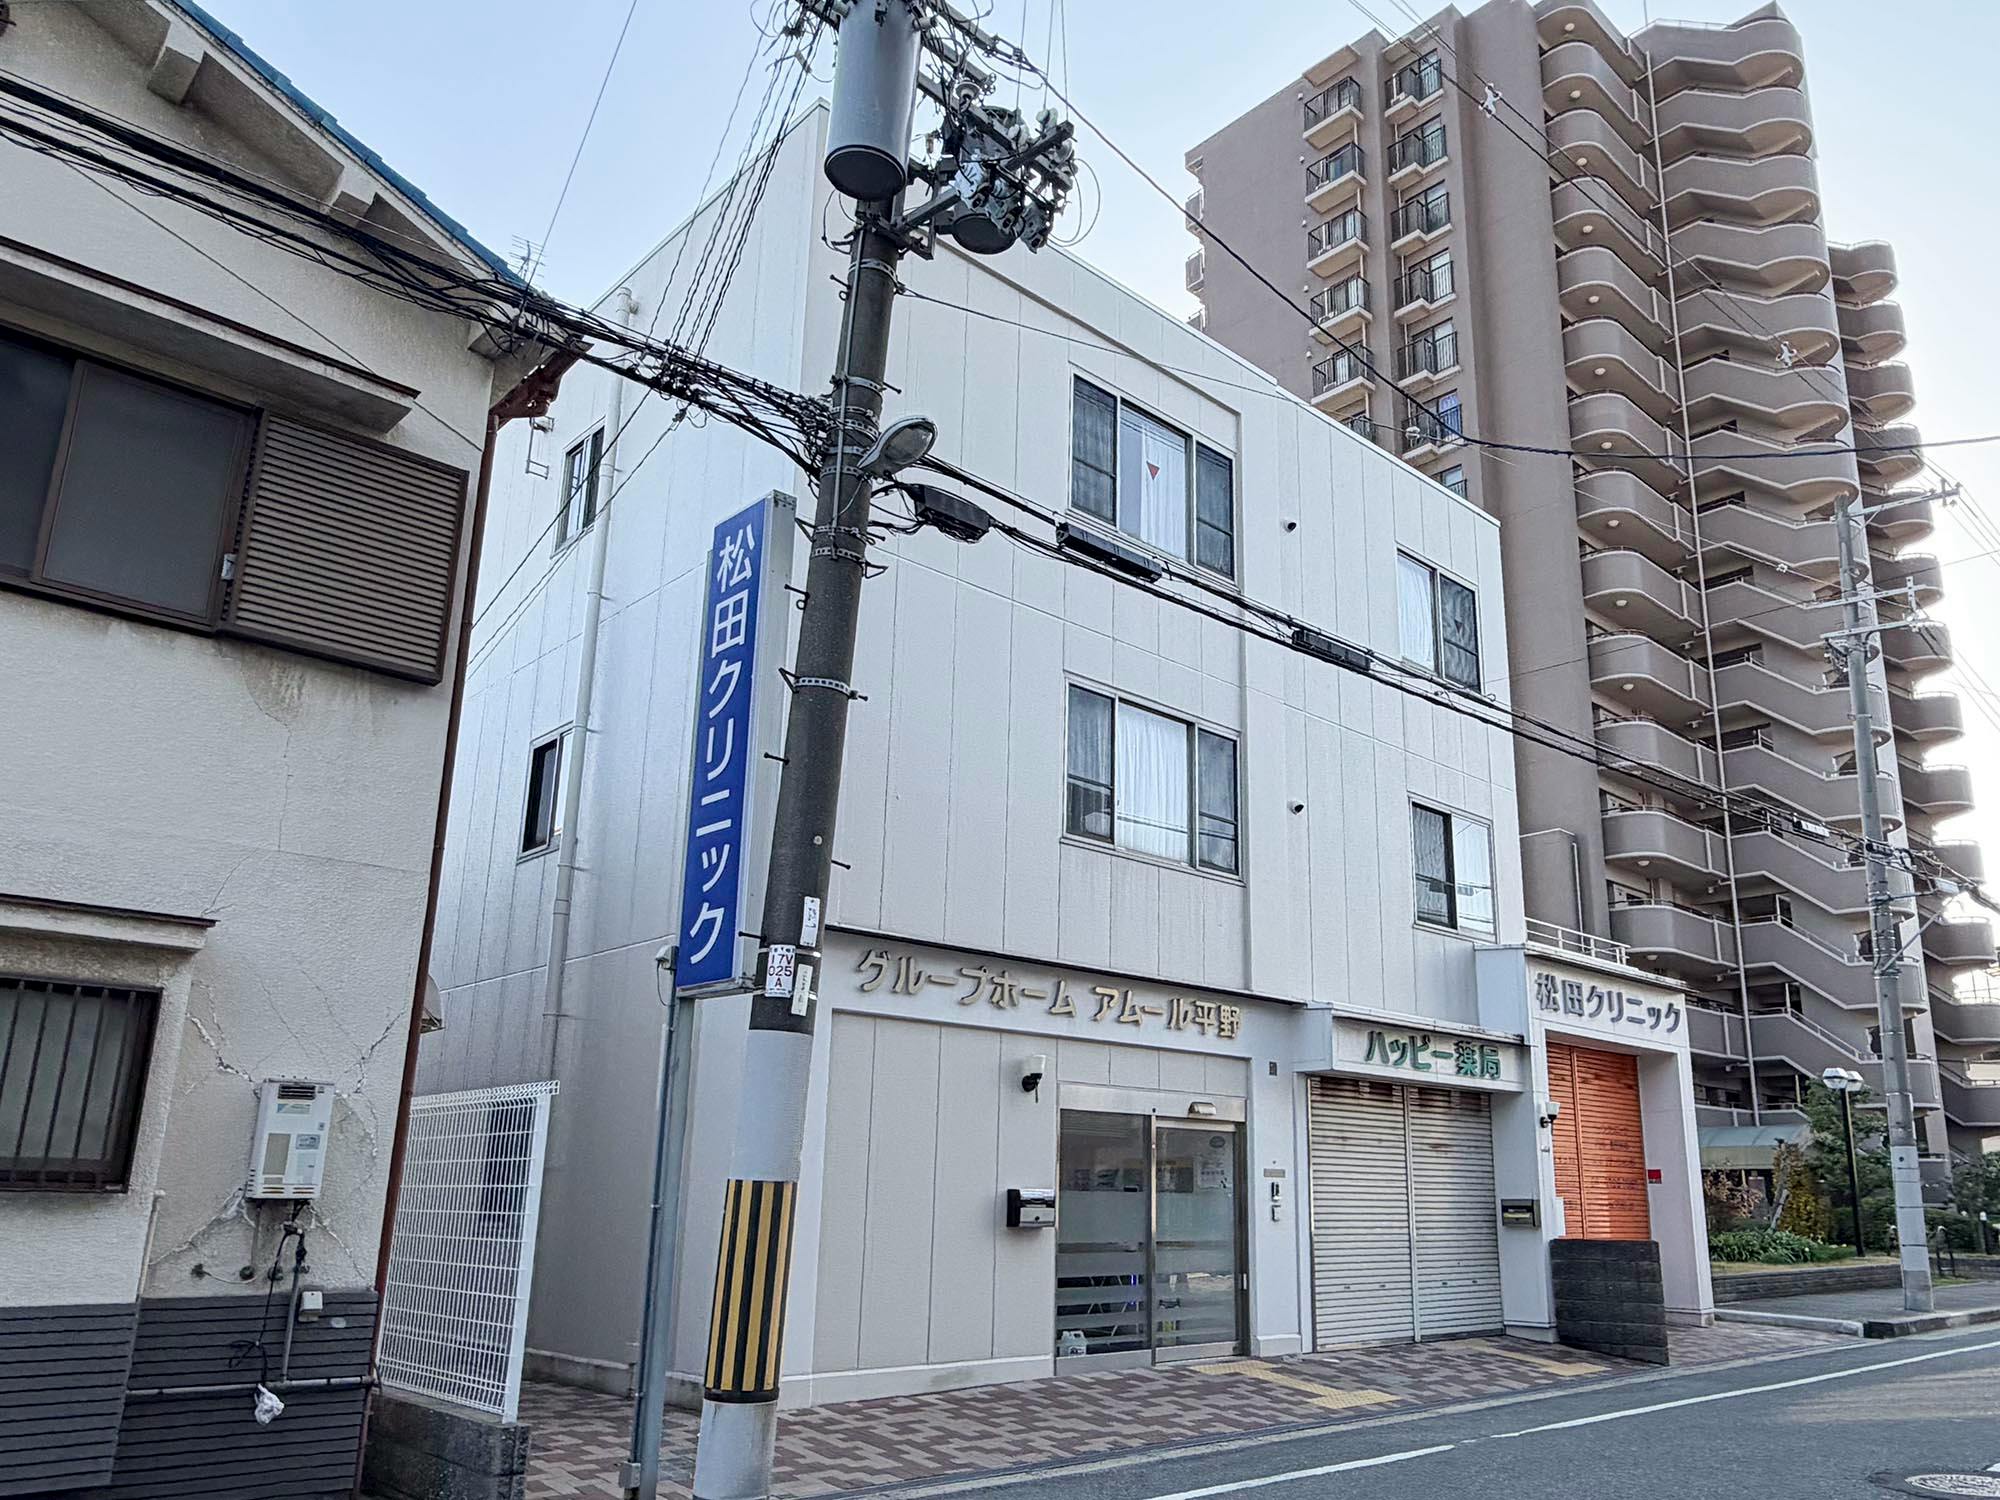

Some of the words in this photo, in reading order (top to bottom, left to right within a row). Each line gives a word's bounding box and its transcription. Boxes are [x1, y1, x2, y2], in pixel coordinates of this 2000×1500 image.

[689, 521, 755, 965] 松田クリニック
[768, 965, 792, 977] 025
[771, 953, 794, 965] 17V
[774, 977, 782, 988] A
[857, 950, 1076, 1017] グループホーム
[1091, 986, 1240, 1039] アムール平野
[1535, 973, 1680, 1033] 松田クリニック
[1364, 1030, 1500, 1080] ハッピー薬局
